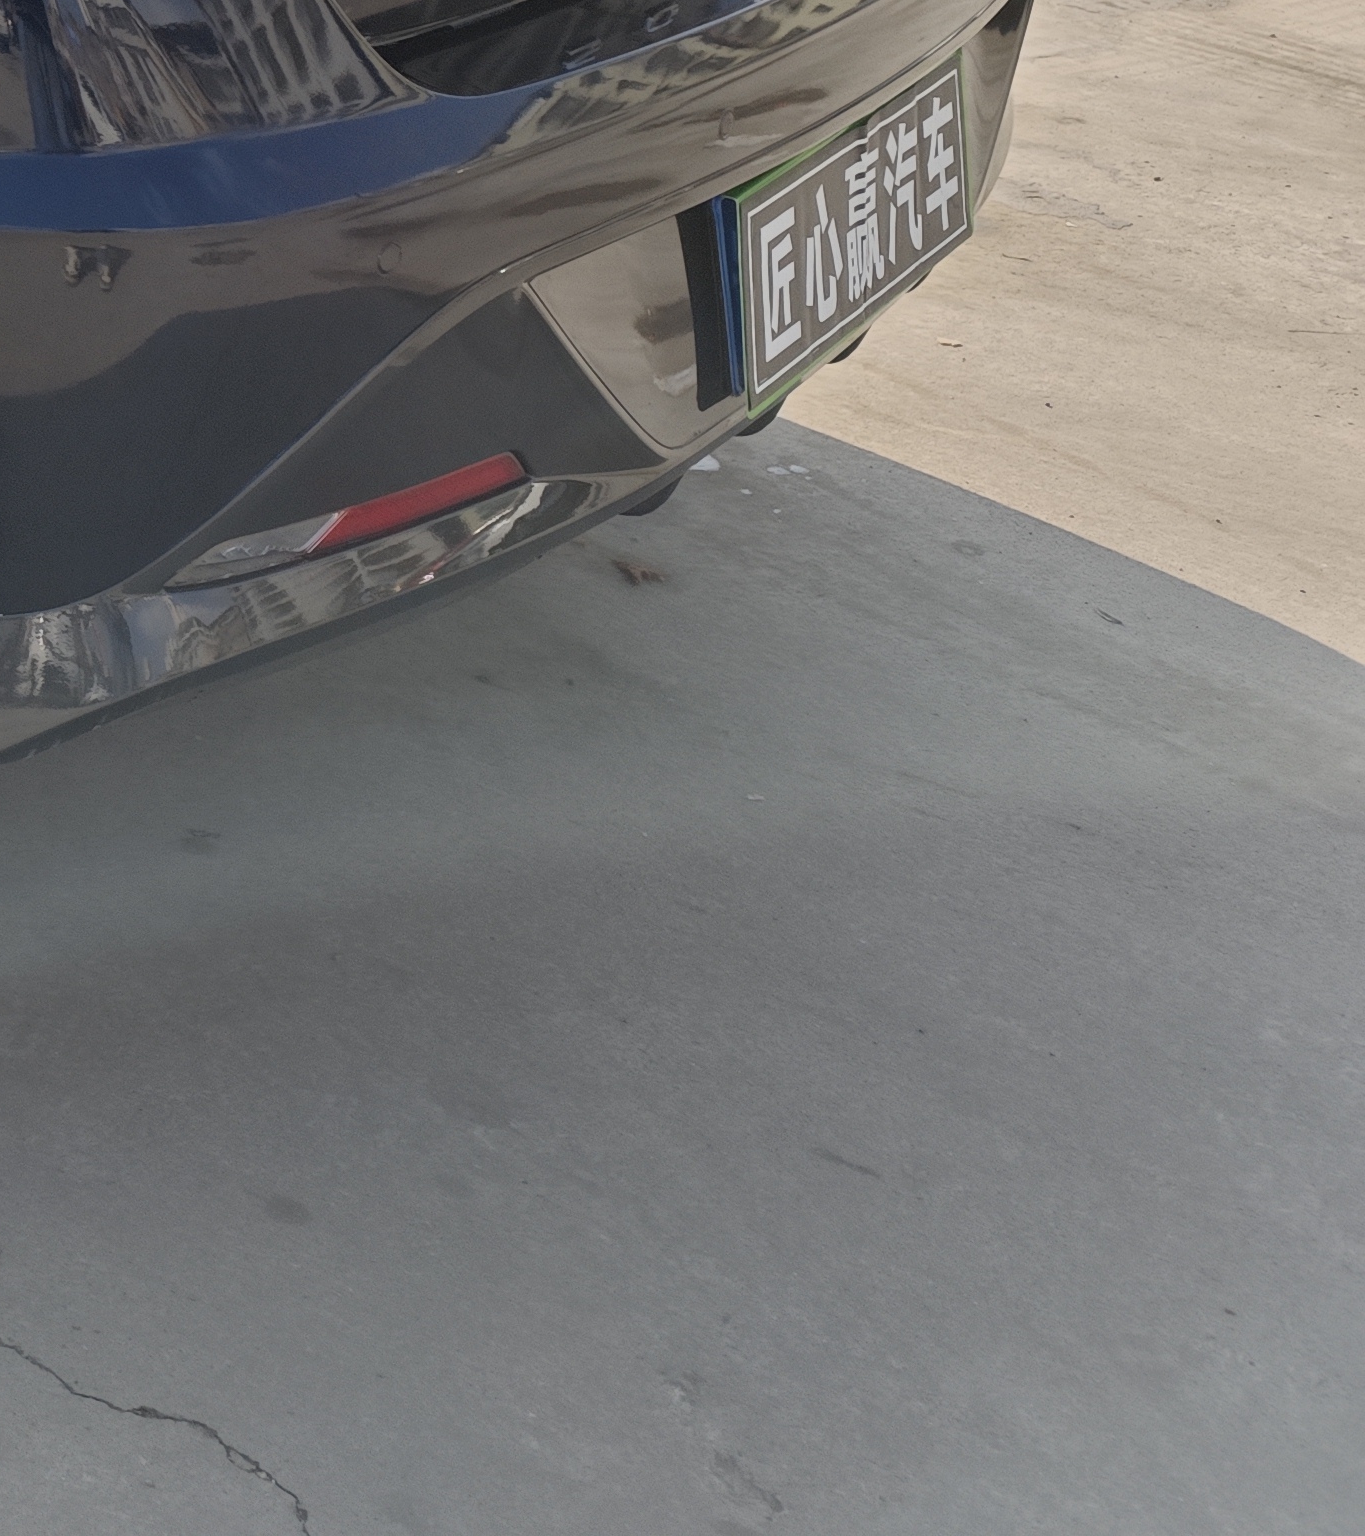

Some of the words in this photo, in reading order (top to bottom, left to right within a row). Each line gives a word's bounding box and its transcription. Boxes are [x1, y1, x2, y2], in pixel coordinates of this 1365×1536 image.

[760, 97, 959, 362] 匠心赢汽车
